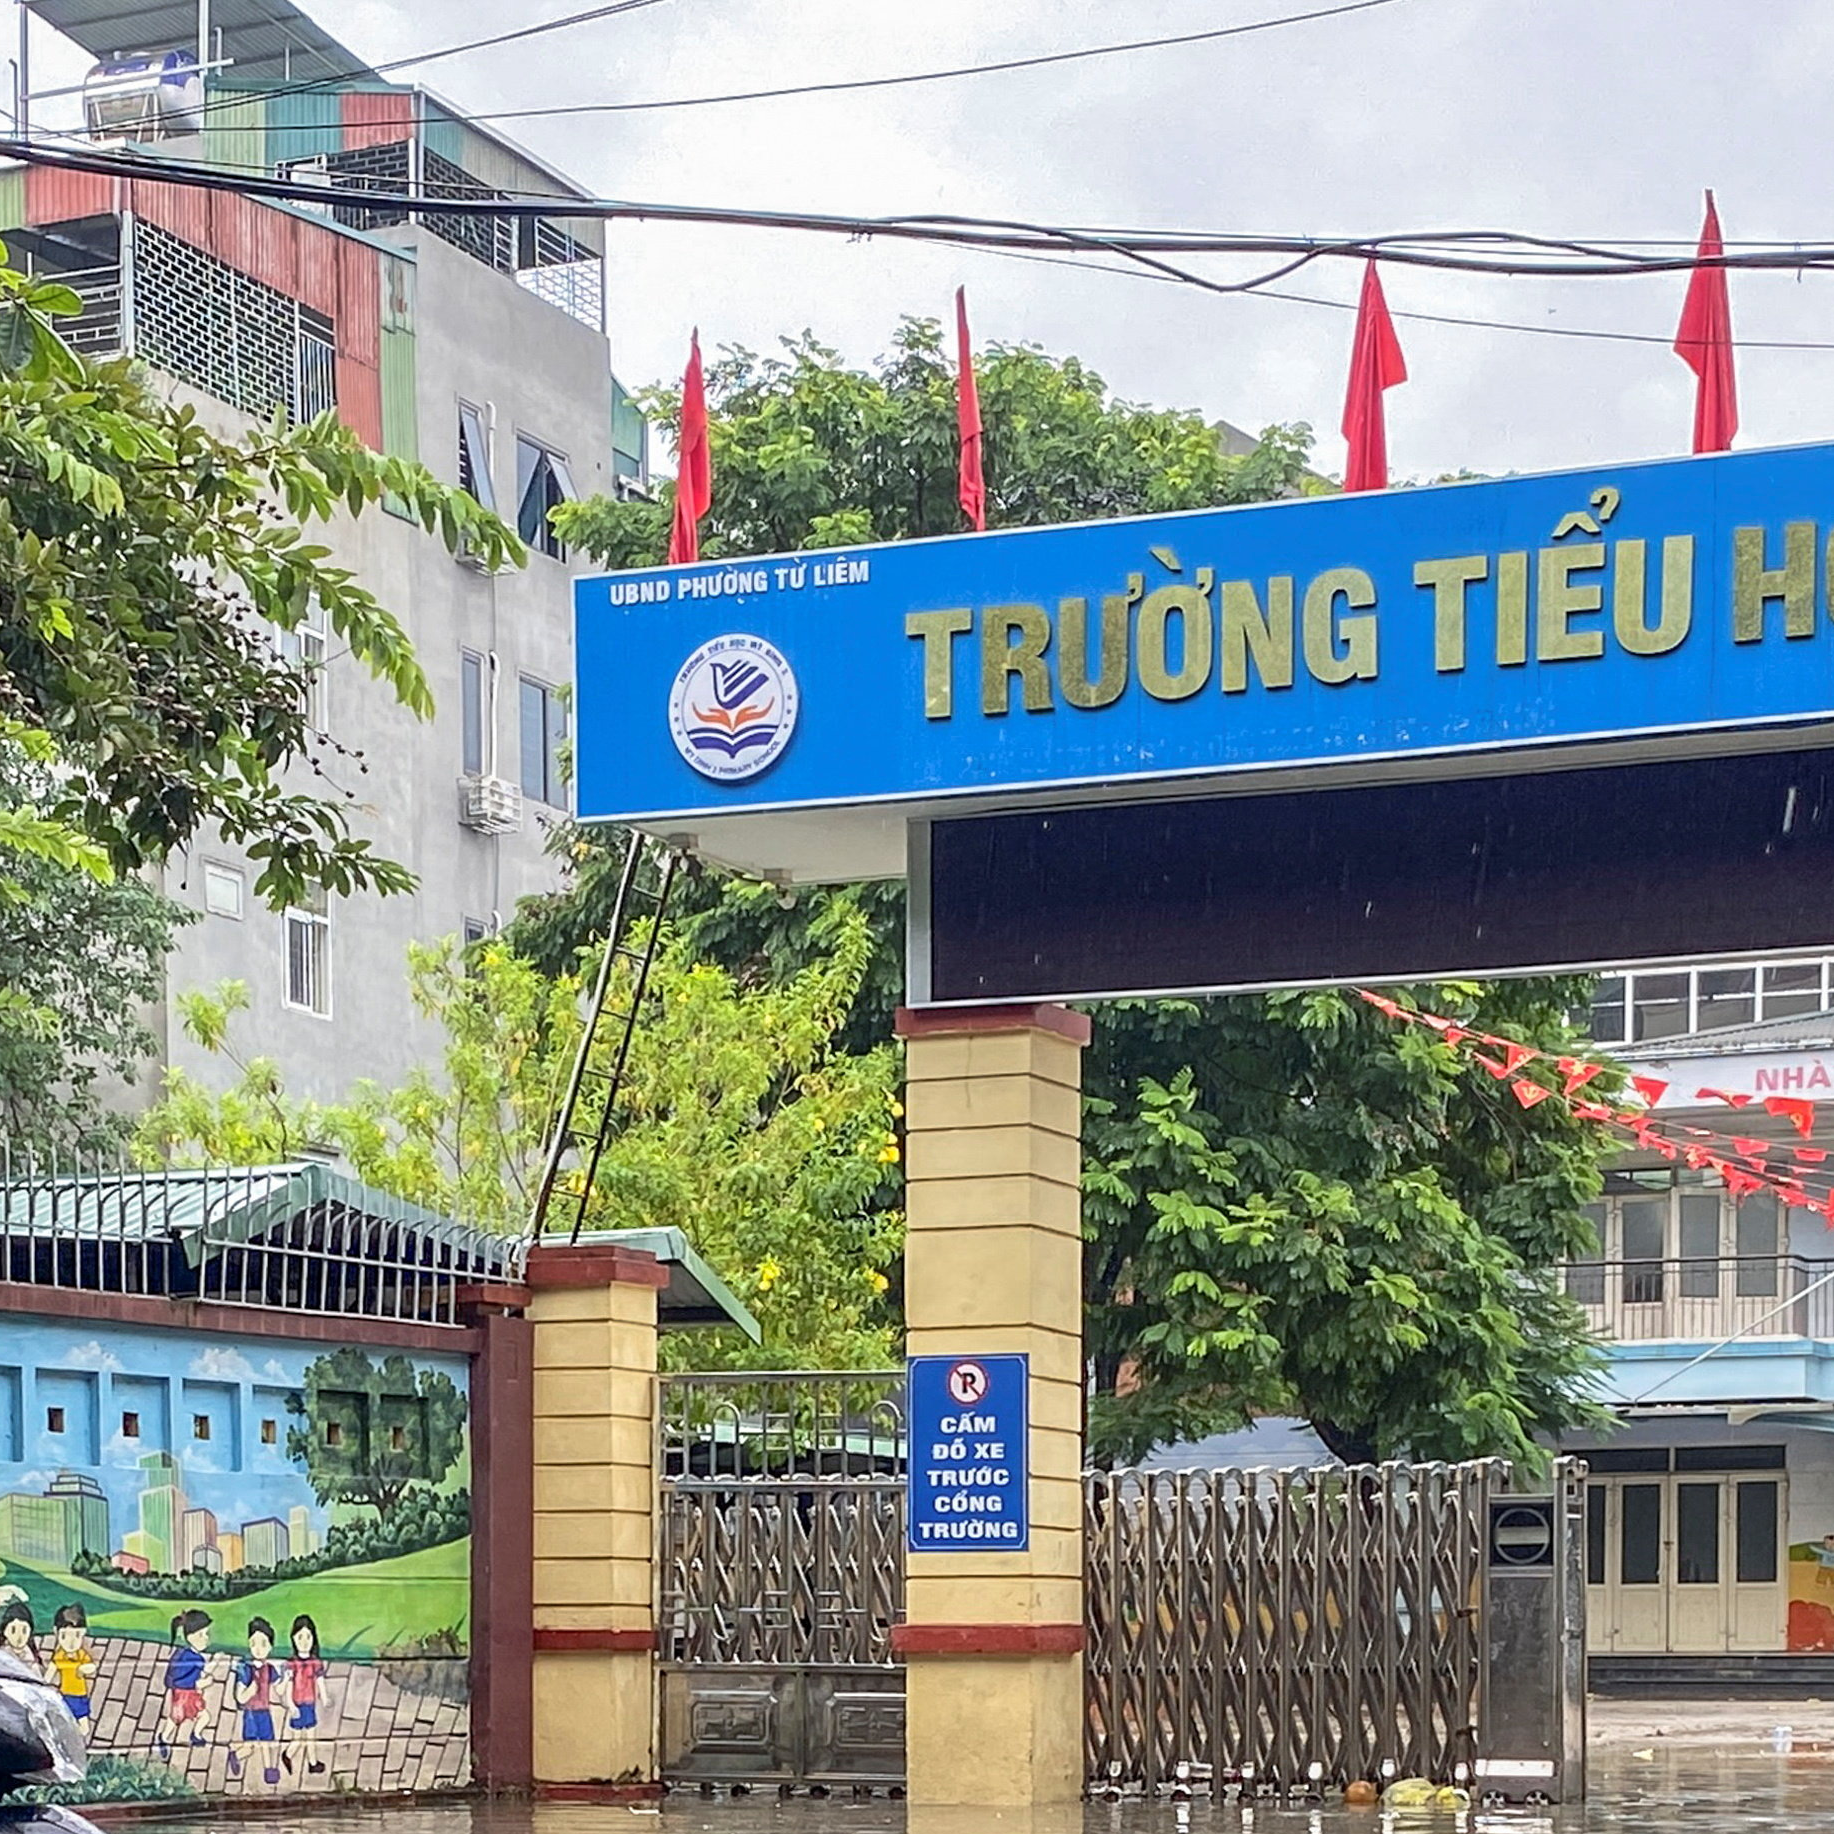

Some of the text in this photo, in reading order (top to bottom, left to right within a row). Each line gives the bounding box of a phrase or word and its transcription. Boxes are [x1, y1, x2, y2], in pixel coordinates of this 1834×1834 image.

[609, 556, 870, 606] UBND PHƯỜNG TỪ LIÊM
[904, 546, 1378, 721] TRƯỜNG
[1413, 487, 1694, 674] TIỂU
[1755, 1058, 1832, 1092] NHÀ
[940, 1411, 996, 1434] CẤM
[932, 1438, 1005, 1460] ĐỖ XE
[927, 1465, 1010, 1487] TRƯỚC
[934, 1489, 1003, 1512] CỔNG
[919, 1519, 1018, 1539] TRƯỜNG
